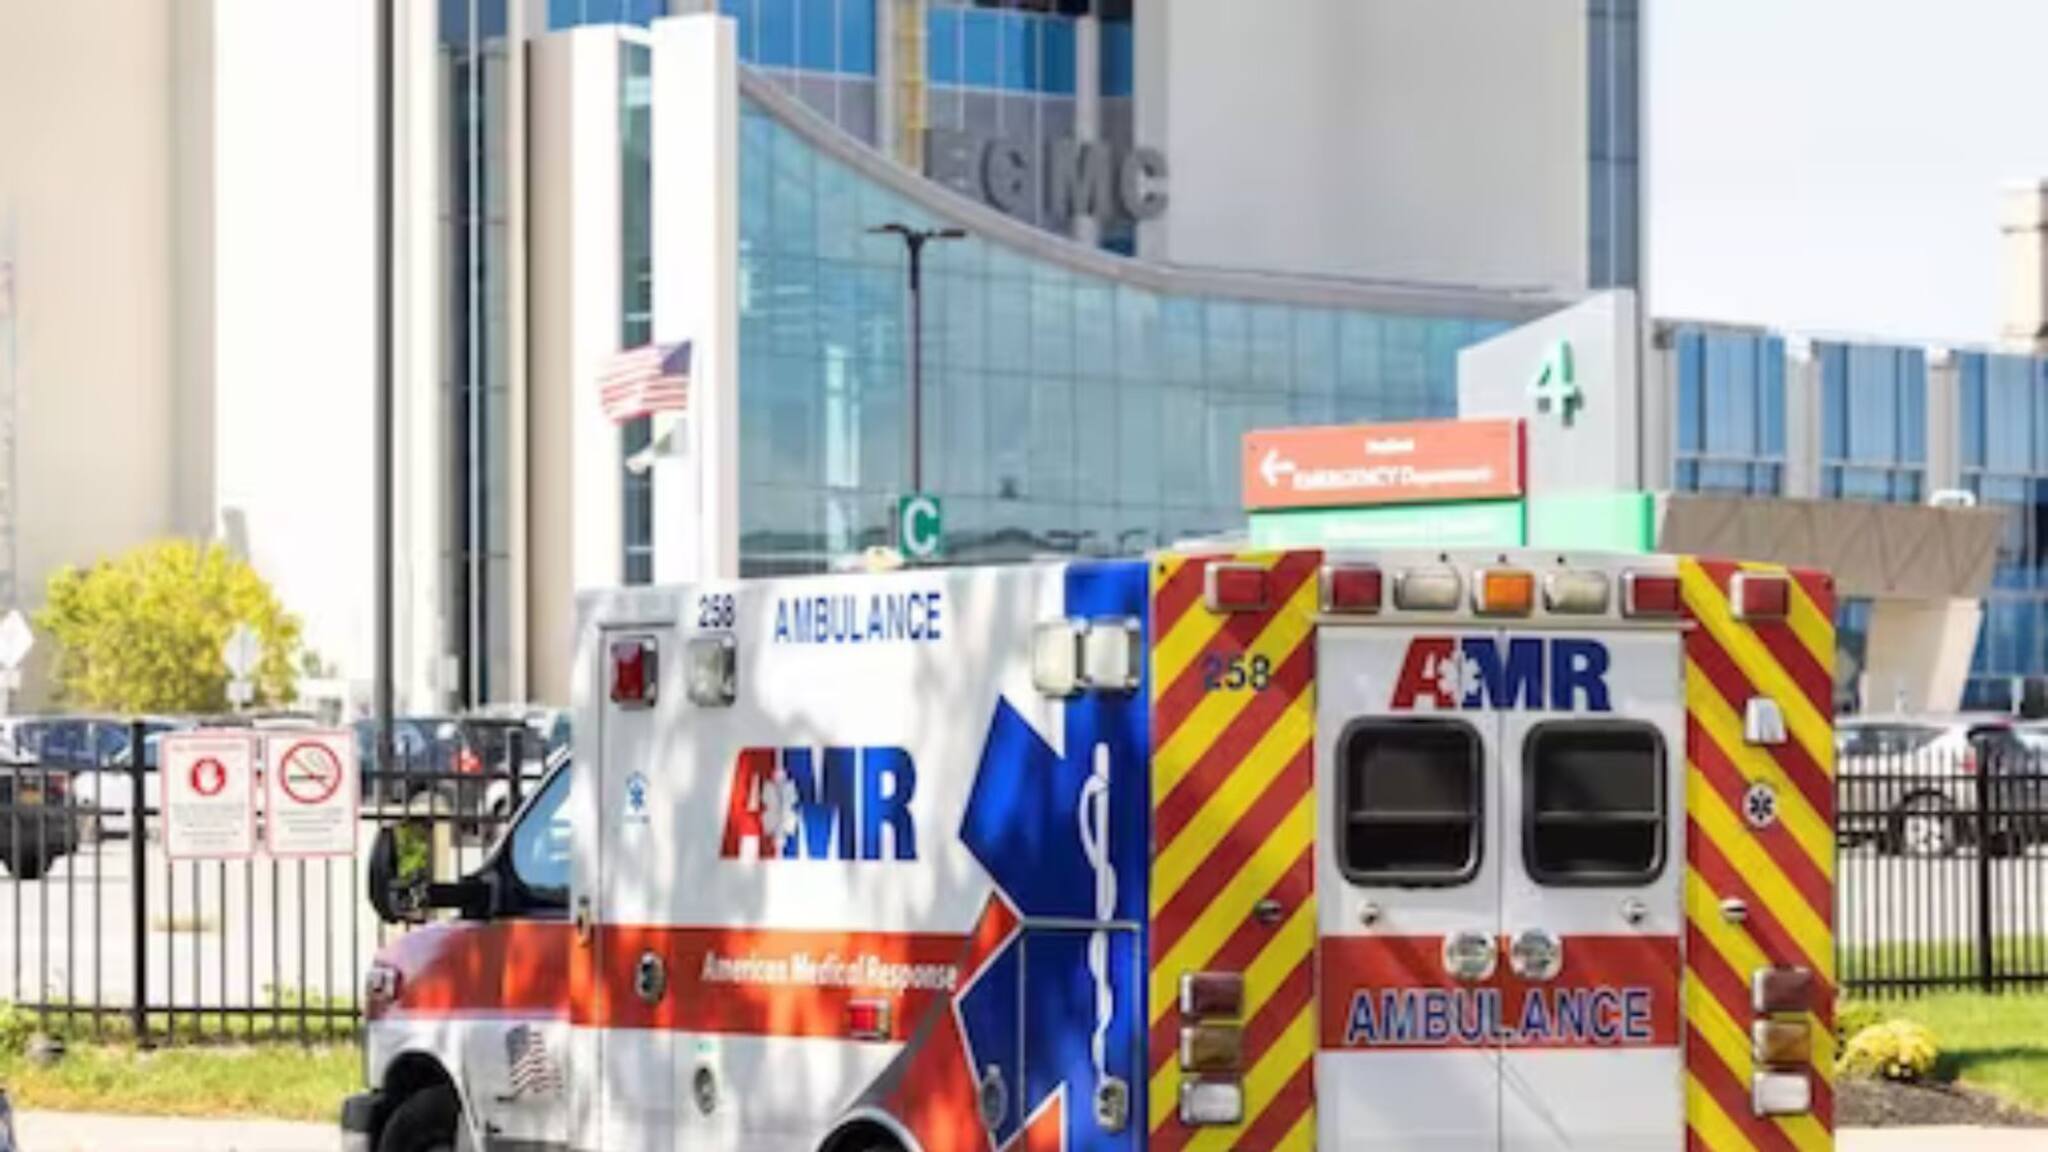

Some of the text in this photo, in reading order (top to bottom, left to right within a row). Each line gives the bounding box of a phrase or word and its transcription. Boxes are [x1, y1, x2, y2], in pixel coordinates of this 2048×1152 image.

[1528, 340, 1584, 427] 4
[903, 498, 937, 555] C
[698, 593, 735, 629] 258
[773, 591, 942, 643] AMBULANCE
[1202, 653, 1272, 692] 258
[1389, 637, 1611, 712] AMR
[720, 747, 918, 861] AMR
[702, 949, 958, 996] American Medical Response
[1346, 987, 1654, 1046] AMBULANCE
